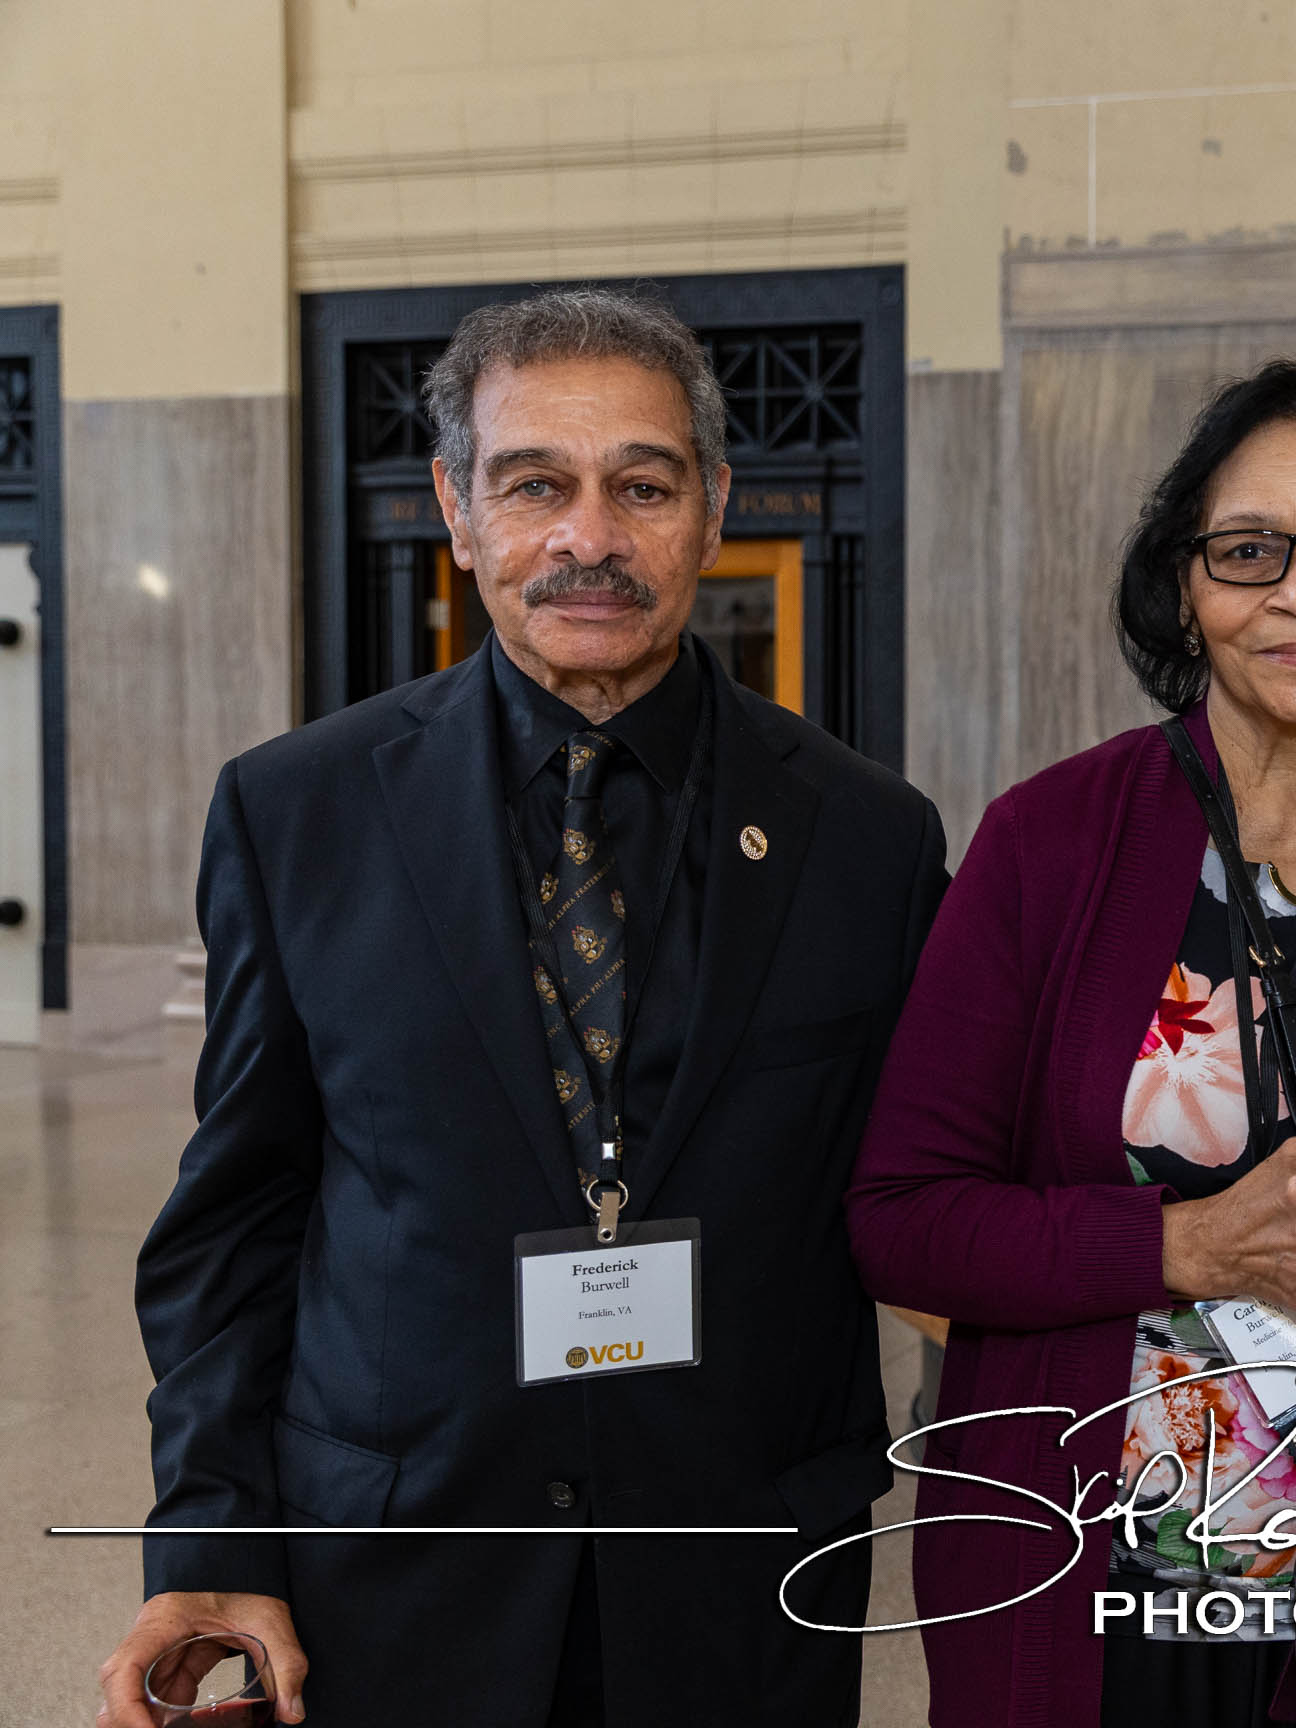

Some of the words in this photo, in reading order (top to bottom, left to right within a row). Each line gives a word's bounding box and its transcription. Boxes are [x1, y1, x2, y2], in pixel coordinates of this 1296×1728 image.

[738, 492, 821, 515] FORUM
[572, 1259, 639, 1277] Frederick
[581, 1277, 630, 1294] Burwell
[578, 1308, 616, 1320] Franklin,
[617, 1307, 633, 1315] VA
[588, 1341, 644, 1365] VCU
